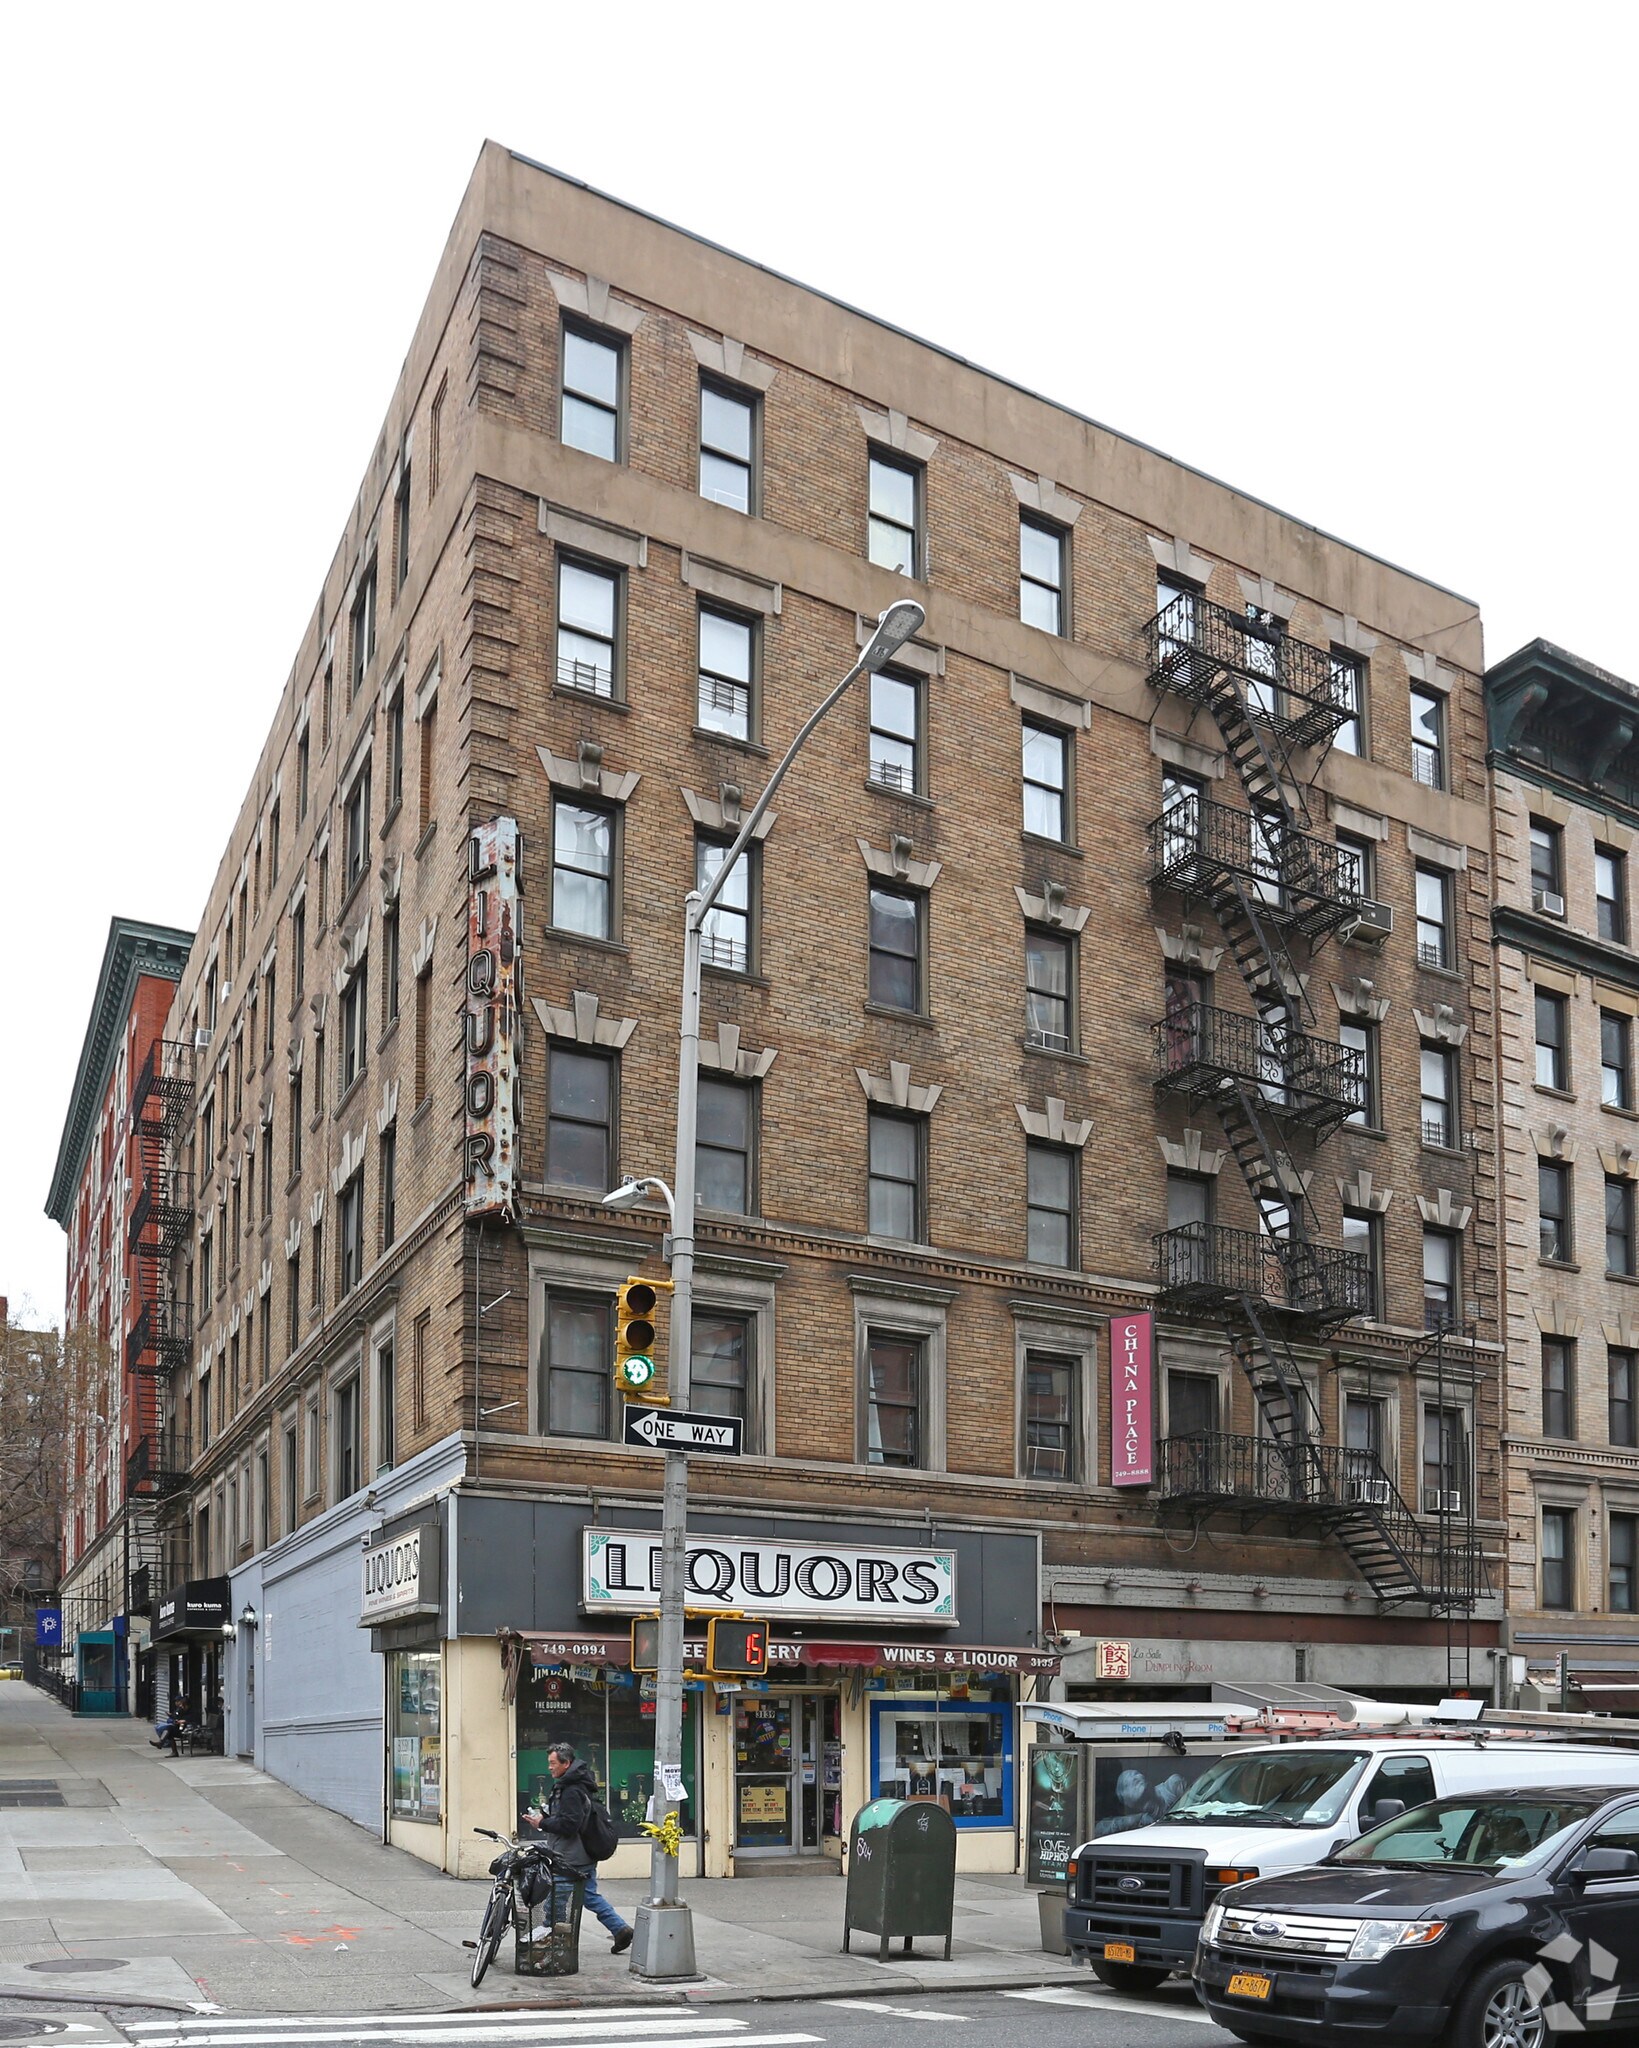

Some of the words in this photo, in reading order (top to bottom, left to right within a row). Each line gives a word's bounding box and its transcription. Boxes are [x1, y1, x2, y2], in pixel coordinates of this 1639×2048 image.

[1124, 1325, 1138, 1392] CHINA
[643, 1420, 675, 1439] ONE
[692, 1426, 726, 1443] WAY
[1125, 1399, 1138, 1465] PLACE
[1115, 1468, 1149, 1478] 749-8888
[366, 1539, 419, 1595] LIQUORS
[606, 1543, 940, 1605] LIQUORS
[542, 1643, 606, 1655] 749-0994
[883, 1648, 935, 1662] WINES
[944, 1651, 955, 1664] &
[962, 1651, 1018, 1667] LIQUOR
[1030, 1657, 1053, 1667] 3139
[531, 1667, 549, 1683] JIM
[1043, 1711, 1062, 1723] Phone
[1121, 1724, 1147, 1733] Phone
[1208, 1724, 1222, 1732] Pho
[1039, 1839, 1066, 1852] LOVE
